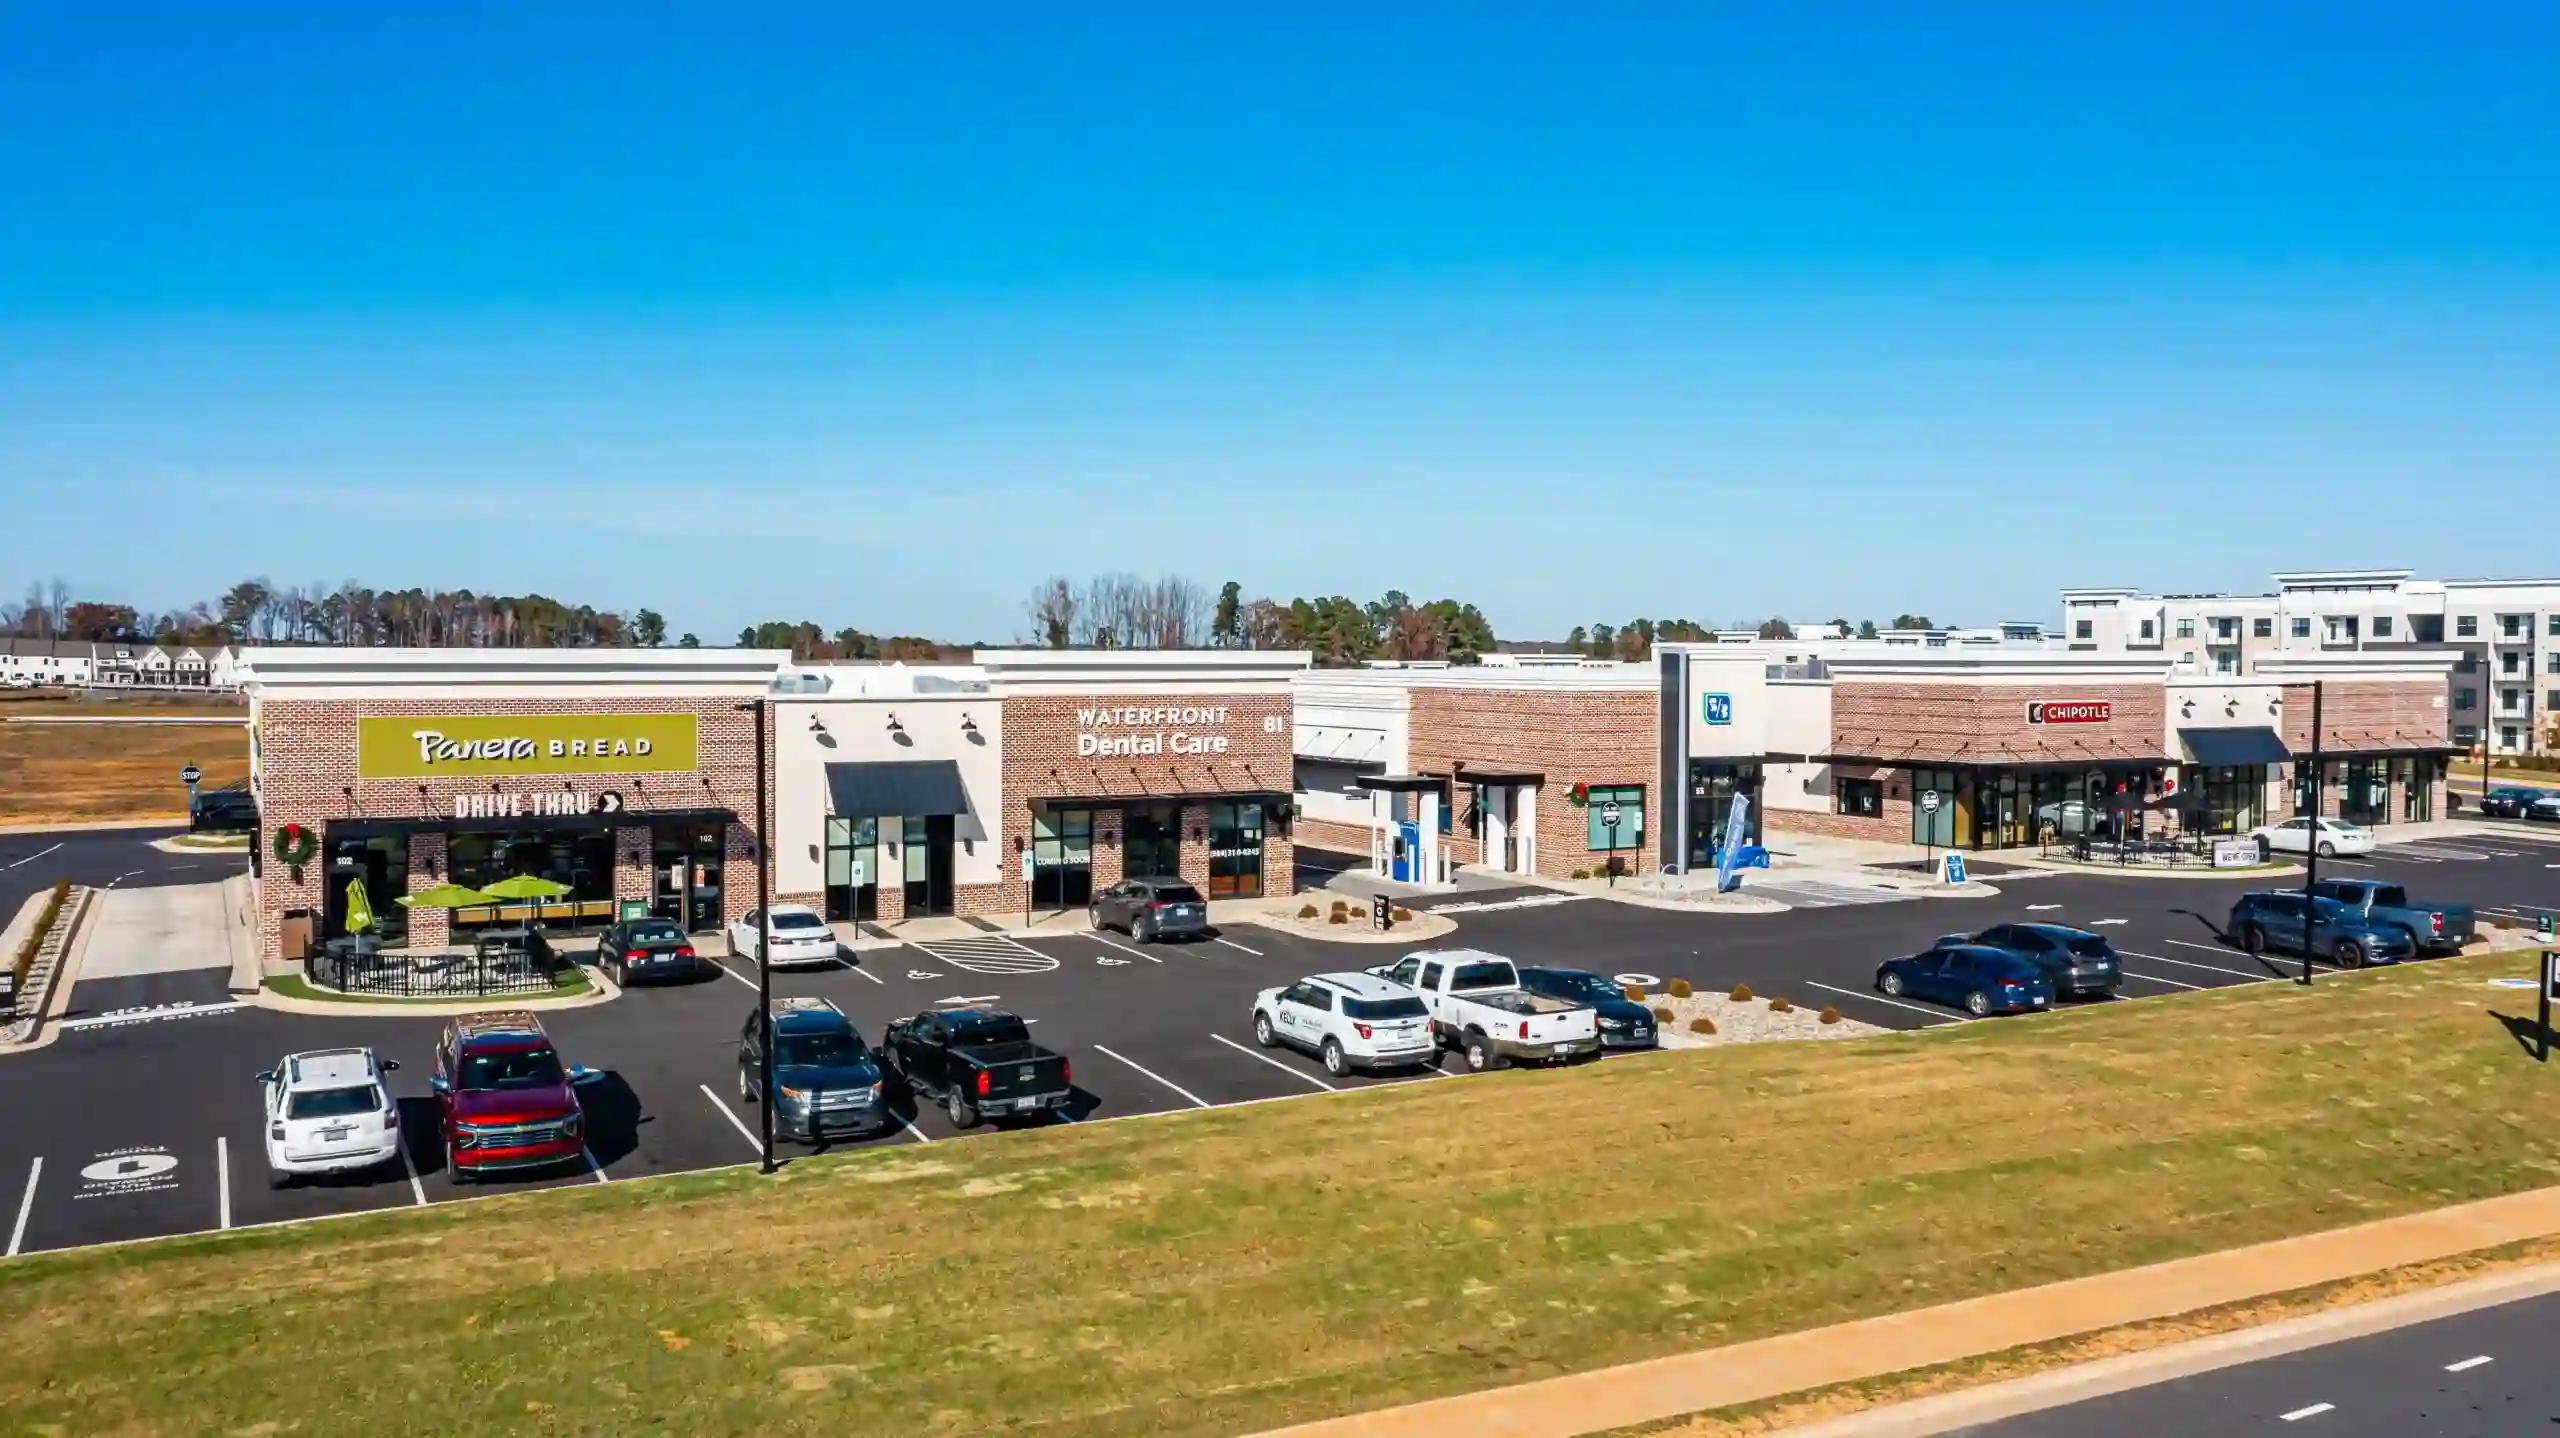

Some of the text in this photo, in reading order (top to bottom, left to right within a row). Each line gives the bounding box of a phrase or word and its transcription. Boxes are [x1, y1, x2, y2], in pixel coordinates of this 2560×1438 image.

[1077, 707, 1229, 727] WATERFRONT
[2048, 706, 2109, 719] CHIPOTLE
[1263, 716, 1284, 733] 81
[411, 730, 653, 764] Panera BREAD
[1078, 731, 1229, 756] Dental Care
[181, 771, 201, 780] STOP
[455, 791, 591, 818] DRIVE THRU
[699, 834, 713, 843] 102
[336, 856, 354, 866] 102
[1069, 855, 1091, 864] SOON
